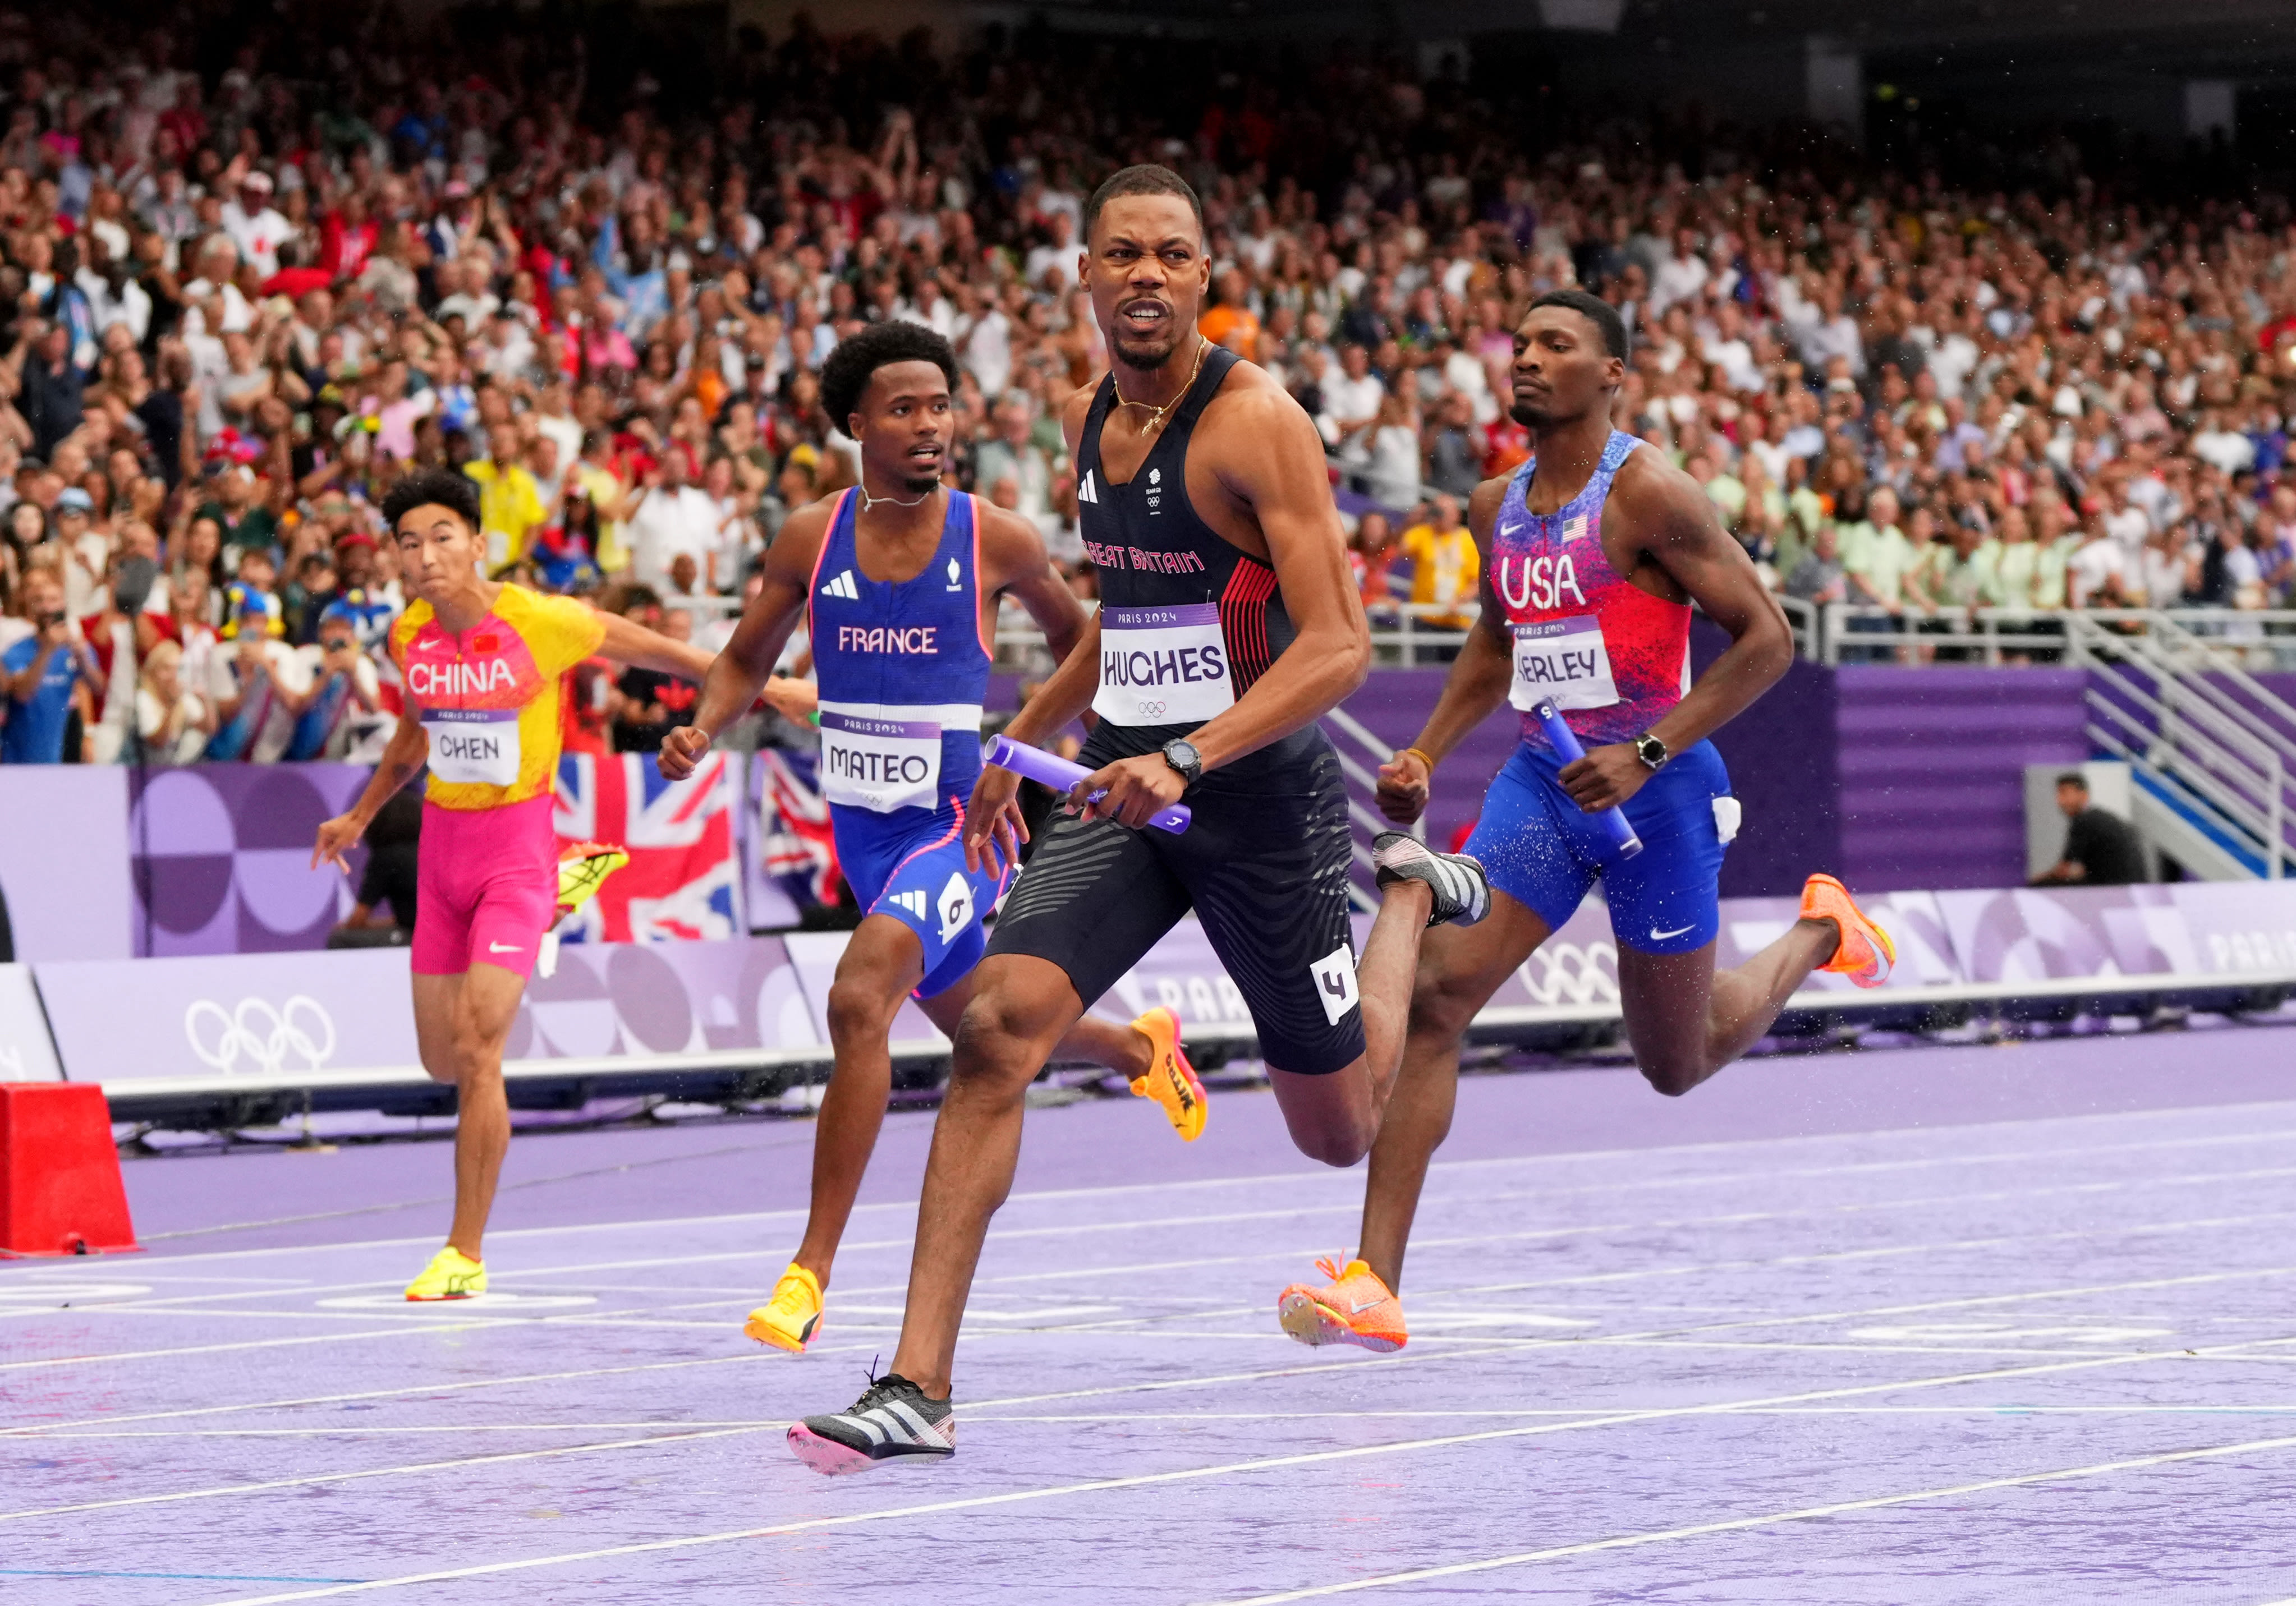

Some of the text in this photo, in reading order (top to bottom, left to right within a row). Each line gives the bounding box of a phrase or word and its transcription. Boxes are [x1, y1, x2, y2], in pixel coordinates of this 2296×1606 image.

[1128, 546, 1205, 573] BRITAIN
[1501, 554, 1586, 609] USA
[1118, 612, 1176, 623] PARIS 2024
[1514, 624, 1565, 636] PARIS 2024
[839, 627, 938, 654] FRANCE
[409, 658, 516, 695] CHINA
[1104, 646, 1224, 686] HUGHES
[844, 719, 904, 734] PARIS 2024
[440, 734, 499, 759] CHEN
[830, 745, 928, 784] MATEO
[949, 898, 965, 924] 6
[1322, 970, 1347, 1000] 4
[1158, 977, 1251, 1021] PAR
